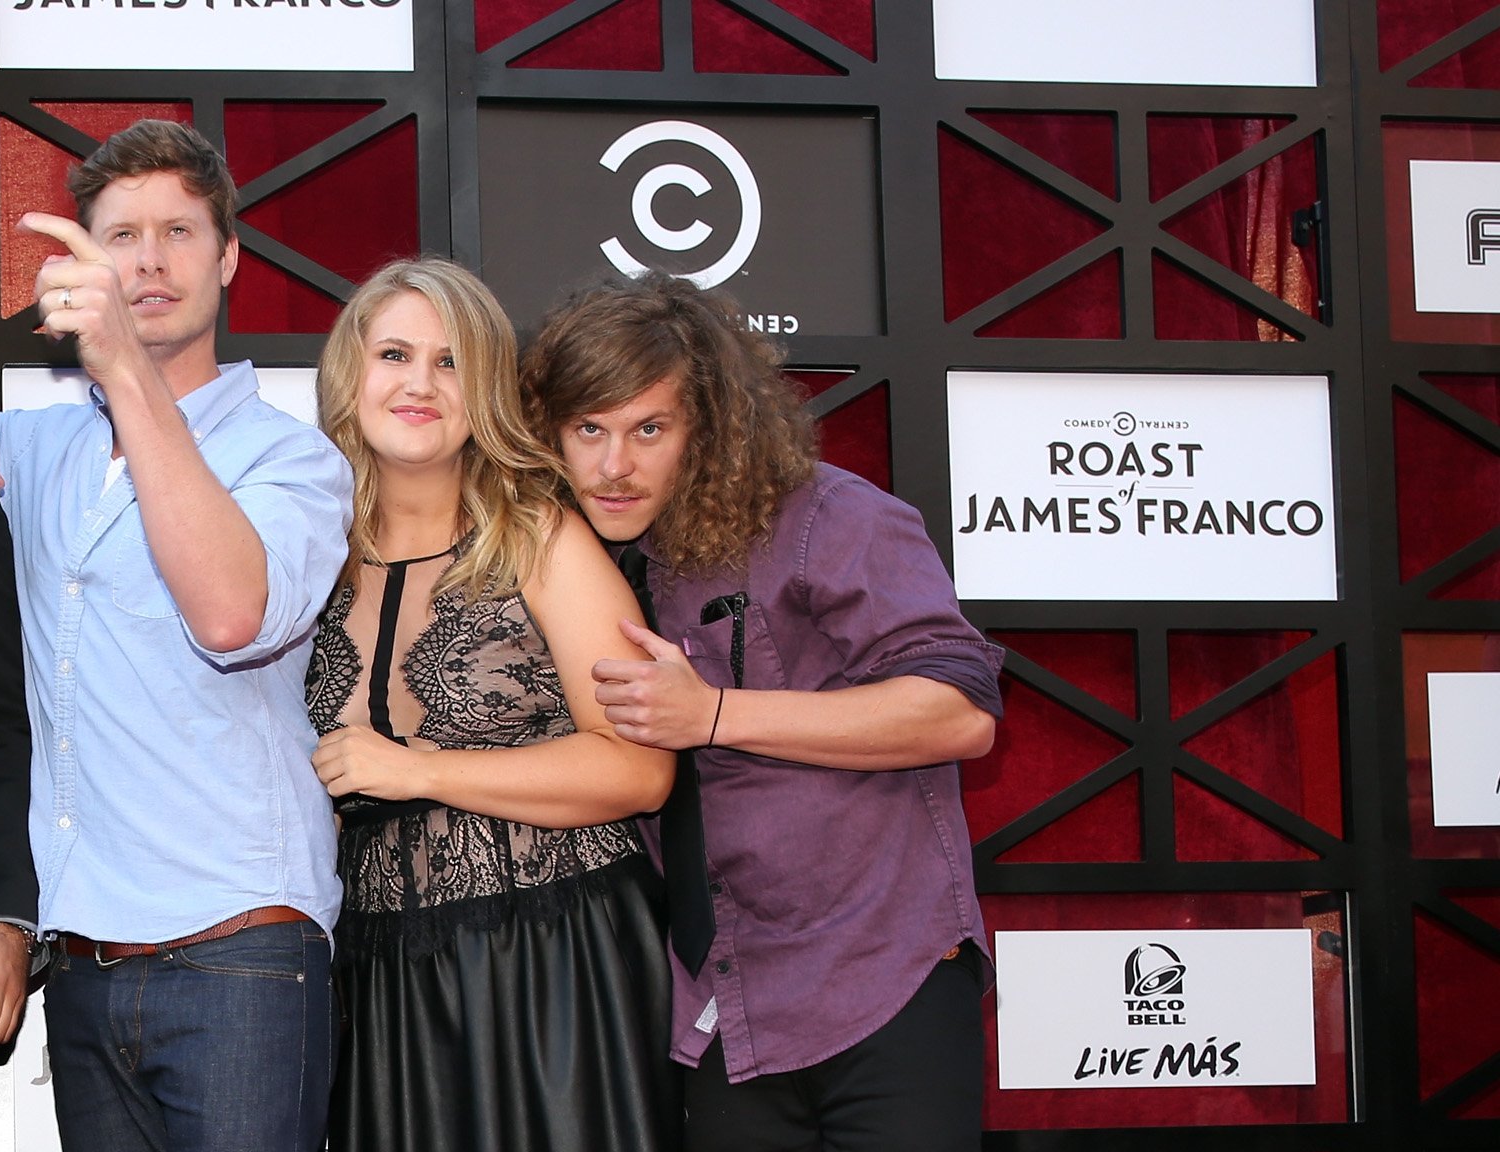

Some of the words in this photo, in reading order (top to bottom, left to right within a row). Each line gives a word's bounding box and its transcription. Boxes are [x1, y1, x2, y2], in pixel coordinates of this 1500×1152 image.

[1063, 419, 1111, 428] COMEDY
[1046, 441, 1203, 478] ROAST
[1118, 481, 1140, 505] of
[958, 493, 1122, 535] JAMES
[1136, 499, 1324, 536] FRANCO
[1123, 999, 1185, 1012] TACO
[1127, 1014, 1186, 1026] BELL
[1152, 1036, 1242, 1080] MÁS
